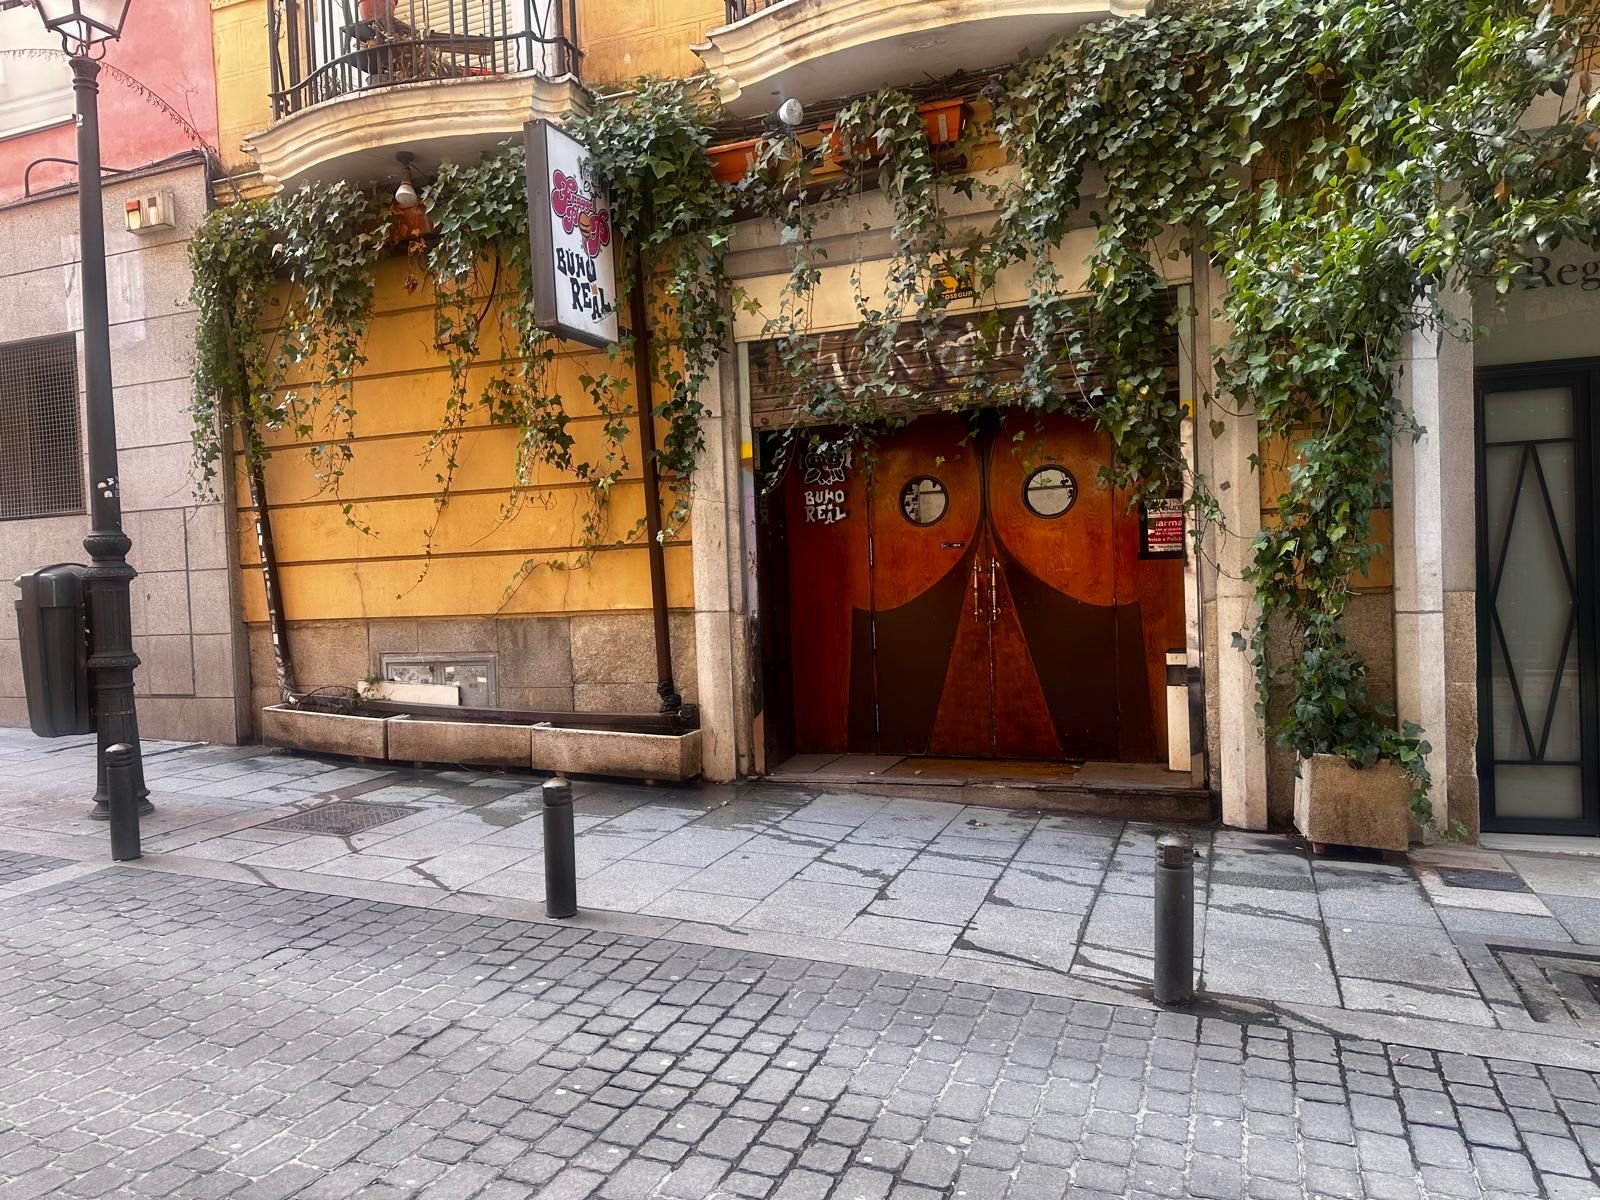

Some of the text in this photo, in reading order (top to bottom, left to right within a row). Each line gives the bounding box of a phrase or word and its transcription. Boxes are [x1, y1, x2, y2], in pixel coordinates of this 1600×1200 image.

[570, 277, 611, 320] REAL
[804, 490, 844, 505] BUHO
[804, 504, 847, 524] REAL
